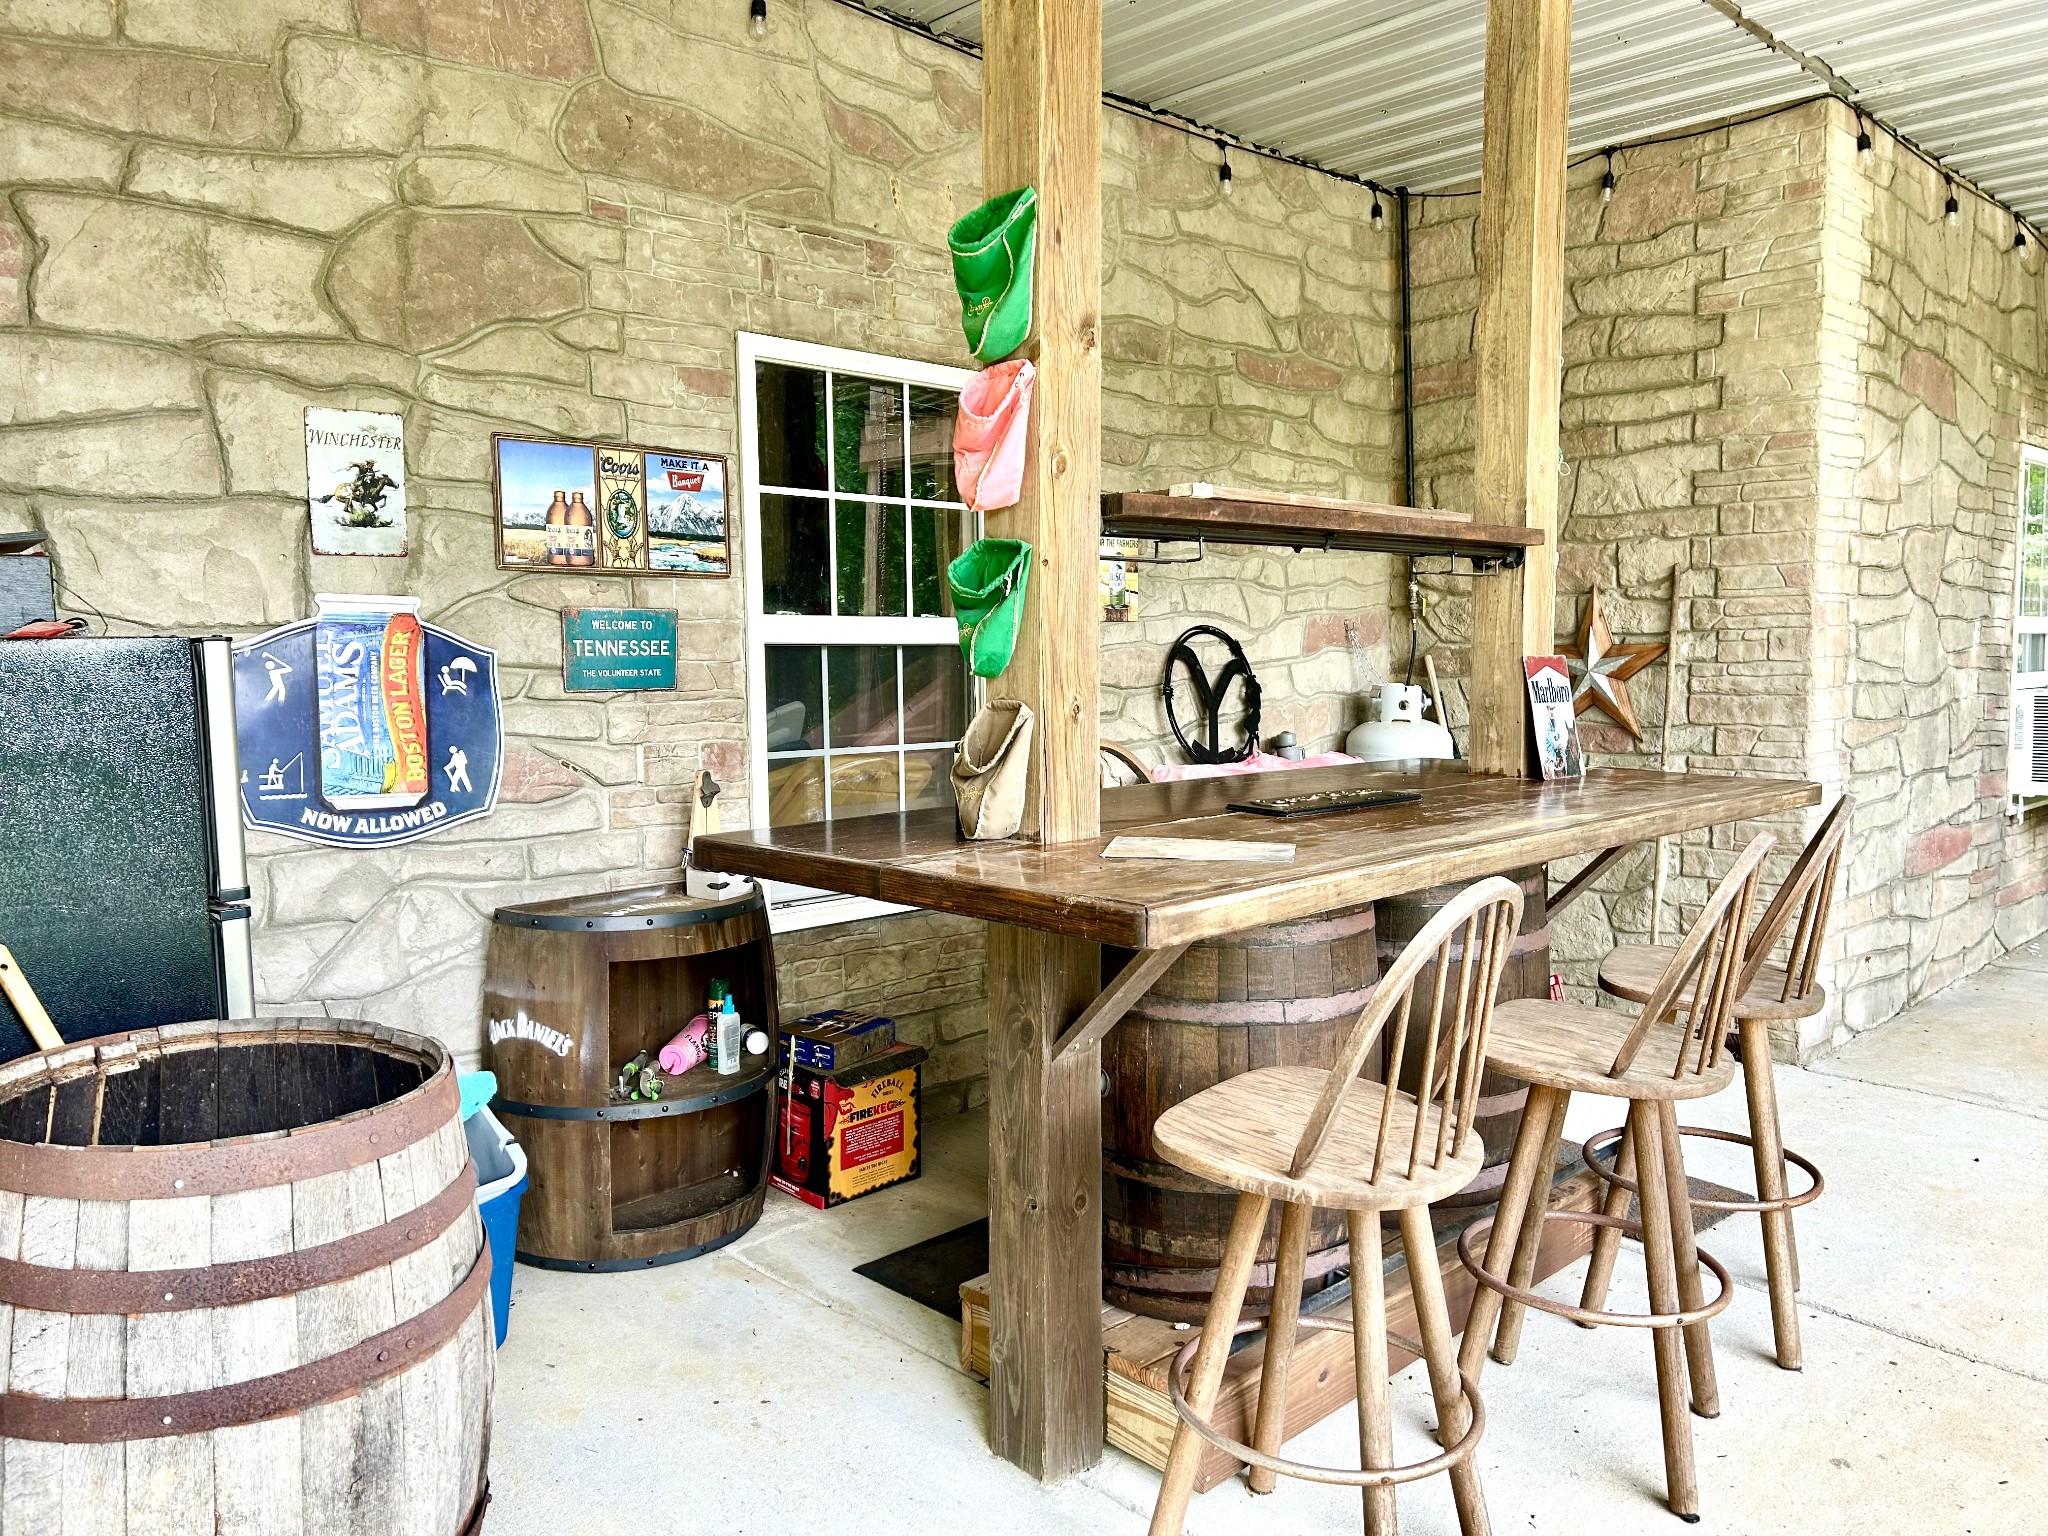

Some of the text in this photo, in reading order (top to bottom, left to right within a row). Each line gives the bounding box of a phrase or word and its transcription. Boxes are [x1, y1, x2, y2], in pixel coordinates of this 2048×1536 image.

[309, 429, 401, 450] WINCHESTER
[600, 456, 639, 475] Coors
[660, 458, 710, 471] MAKE IT A
[671, 474, 701, 489] Banquet
[591, 620, 653, 630] WELCOME TO
[573, 640, 670, 656] TENNESSEE
[369, 650, 380, 684] COMPANY
[597, 669, 639, 677] VOLUNTEER
[640, 668, 662, 676] STATE
[332, 641, 371, 760] ADAMS
[371, 686, 380, 703] BEER
[1531, 678, 1570, 704] Marlboro
[388, 630, 427, 782] BOSTON LAGER
[371, 704, 380, 732] BOSTON
[301, 801, 447, 834] NOW ALLOWED
[489, 1018, 516, 1045] JACK
[871, 1078, 905, 1099] FIREBALL
[850, 1100, 896, 1124] FIREKEG
